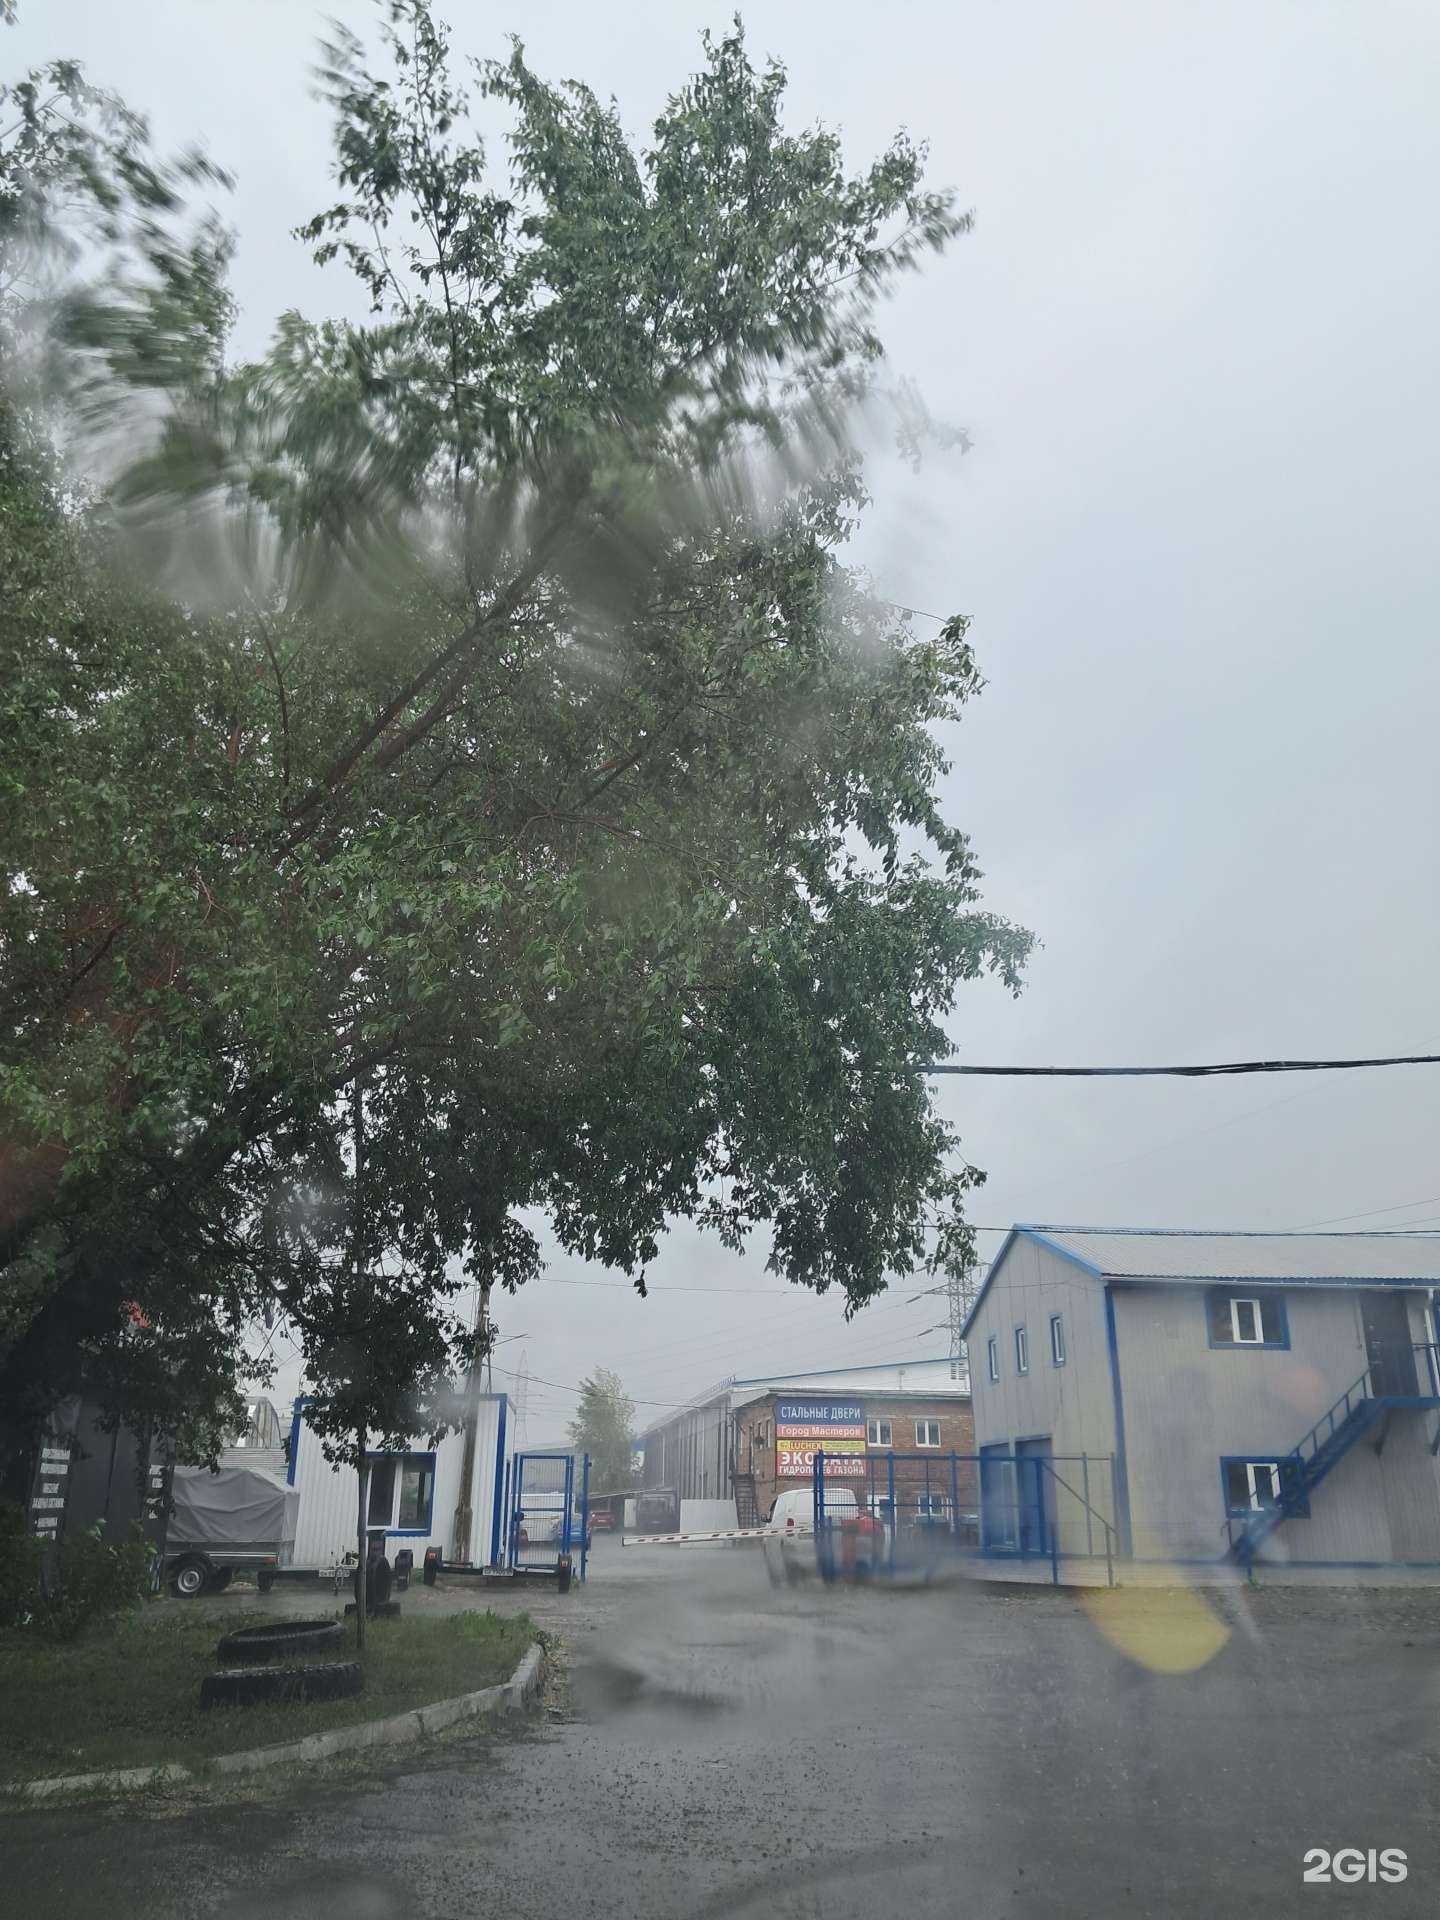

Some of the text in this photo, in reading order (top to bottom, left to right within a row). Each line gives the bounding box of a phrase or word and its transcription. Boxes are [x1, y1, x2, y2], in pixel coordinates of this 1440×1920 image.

[781, 1406, 861, 1420] СТАЛЬНЫЕ ДВЕРИ
[781, 1426, 861, 1437] Город Мастеров
[781, 1451, 862, 1465] ЭКОАТА
[833, 1465, 864, 1475] ГАЗОНА
